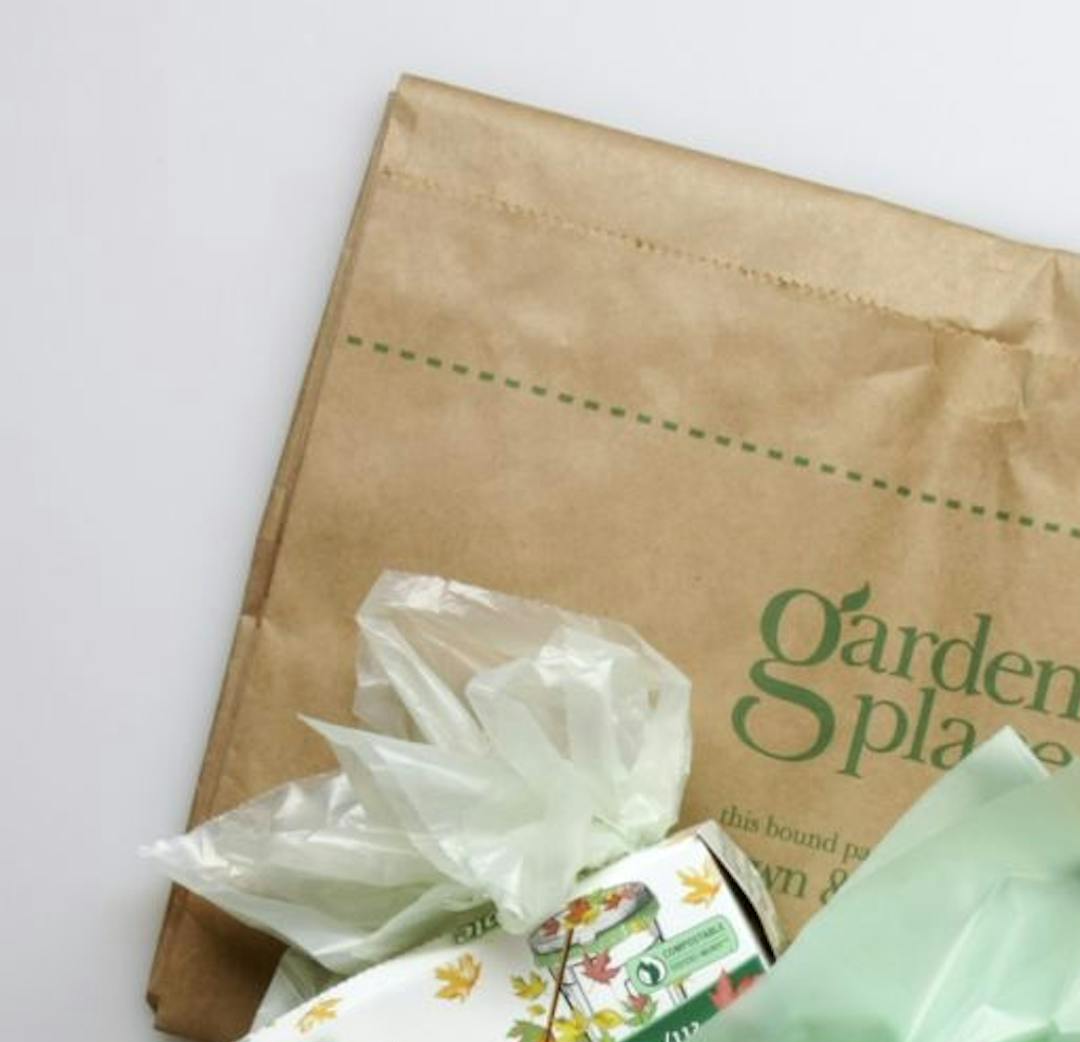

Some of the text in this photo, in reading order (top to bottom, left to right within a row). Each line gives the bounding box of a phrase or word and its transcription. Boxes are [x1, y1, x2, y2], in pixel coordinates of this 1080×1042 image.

[838, 688, 1073, 778] plae
[719, 803, 761, 836] this
[764, 813, 838, 857] bound
